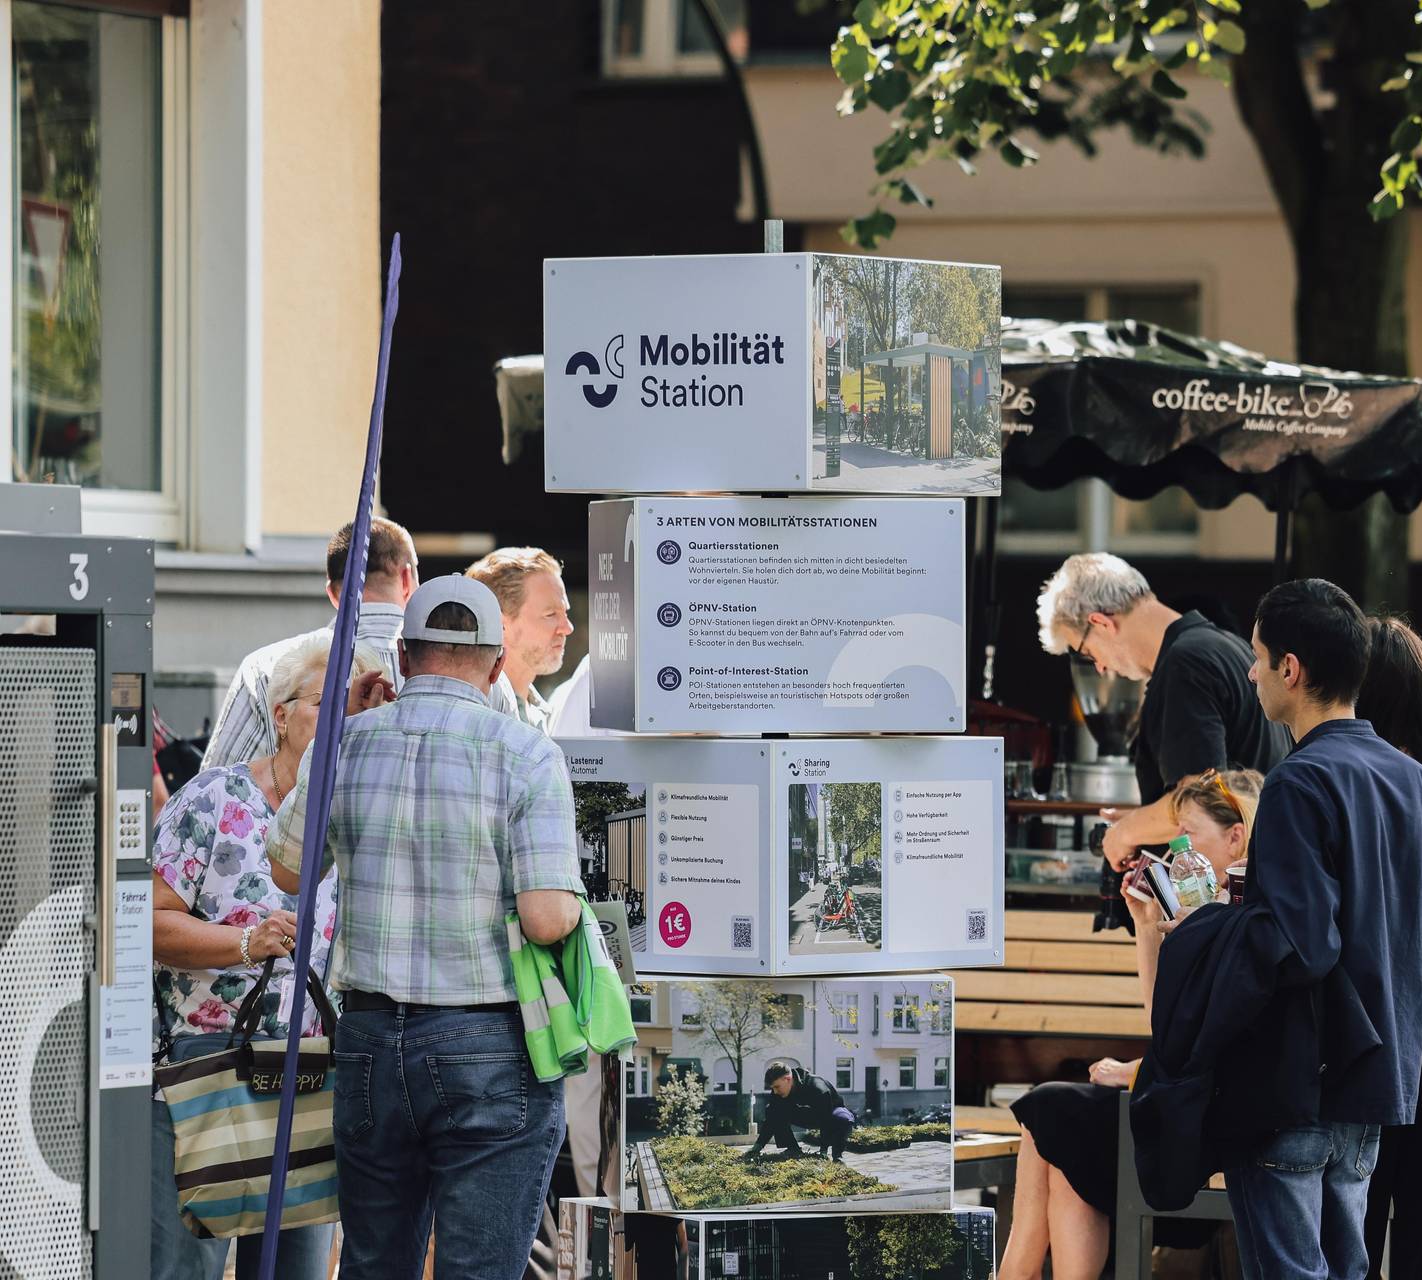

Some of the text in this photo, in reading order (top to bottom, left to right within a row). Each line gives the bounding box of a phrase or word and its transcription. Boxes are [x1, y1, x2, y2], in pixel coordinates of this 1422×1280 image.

[640, 332, 784, 366] Mobilität
[640, 374, 744, 408] Station
[1152, 378, 1291, 416] coffee-bike
[1242, 418, 1348, 438] Mobile Coffee Company
[656, 515, 877, 528] 3 ARTEN VON MOBILITÄTSSTATIONEN
[688, 541, 779, 552] Quartiersstationen
[598, 552, 613, 581] NEUE
[688, 556, 908, 566] Quartiersstationen befinden sich mitten in dicht besiedelten
[68, 552, 90, 602] 3
[688, 566, 741, 575] Wohnvierteln.
[742, 566, 754, 575] Sie
[755, 566, 776, 575] holen
[777, 566, 794, 575] dich
[795, 566, 812, 575] dort
[812, 566, 825, 577] ab,
[839, 566, 860, 575] deine
[861, 566, 895, 575] Mobilität
[896, 566, 928, 577] beginnt:
[702, 576, 715, 585] der
[716, 577, 747, 587] eigenen
[748, 576, 779, 585] Haustür.
[688, 602, 757, 612] ÖPNV-Station
[688, 618, 895, 628] ÖPNV-Stationen liegen direkt an ÖPNV-Knotenpunkten.
[688, 628, 699, 637] So
[700, 628, 725, 637] kannst
[726, 628, 737, 637] du
[738, 628, 769, 639] bequem
[785, 628, 799, 637] der
[799, 628, 819, 637] Bahn
[820, 628, 838, 637] auf's
[839, 628, 868, 637] Fahrrad
[869, 628, 887, 637] oder
[598, 626, 629, 661] MOBILITÄT
[688, 638, 804, 647] E-Scooter in den Bus wechseln.
[689, 666, 809, 676] Point-of-Interest-Station
[688, 681, 742, 689] POI-Stationen
[742, 681, 780, 689] entstehen
[792, 681, 831, 689] besonders
[832, 681, 851, 689] hoch
[852, 681, 906, 692] frequentierten
[688, 691, 713, 702] Orten,
[714, 691, 768, 702] beispielsweise
[780, 691, 828, 700] touristischen
[829, 691, 864, 702] Hotspots
[864, 691, 881, 700] oder
[882, 691, 910, 702] großen
[688, 702, 776, 712] Arbeitgeberstandorten.
[570, 756, 604, 765] Lastenrad
[804, 758, 830, 768] Sharing
[570, 766, 598, 774] Automat
[804, 768, 826, 776] Station
[122, 892, 148, 902] Fahrrad
[664, 912, 686, 934] 1€
[252, 1072, 324, 1091] BE HPPY!
